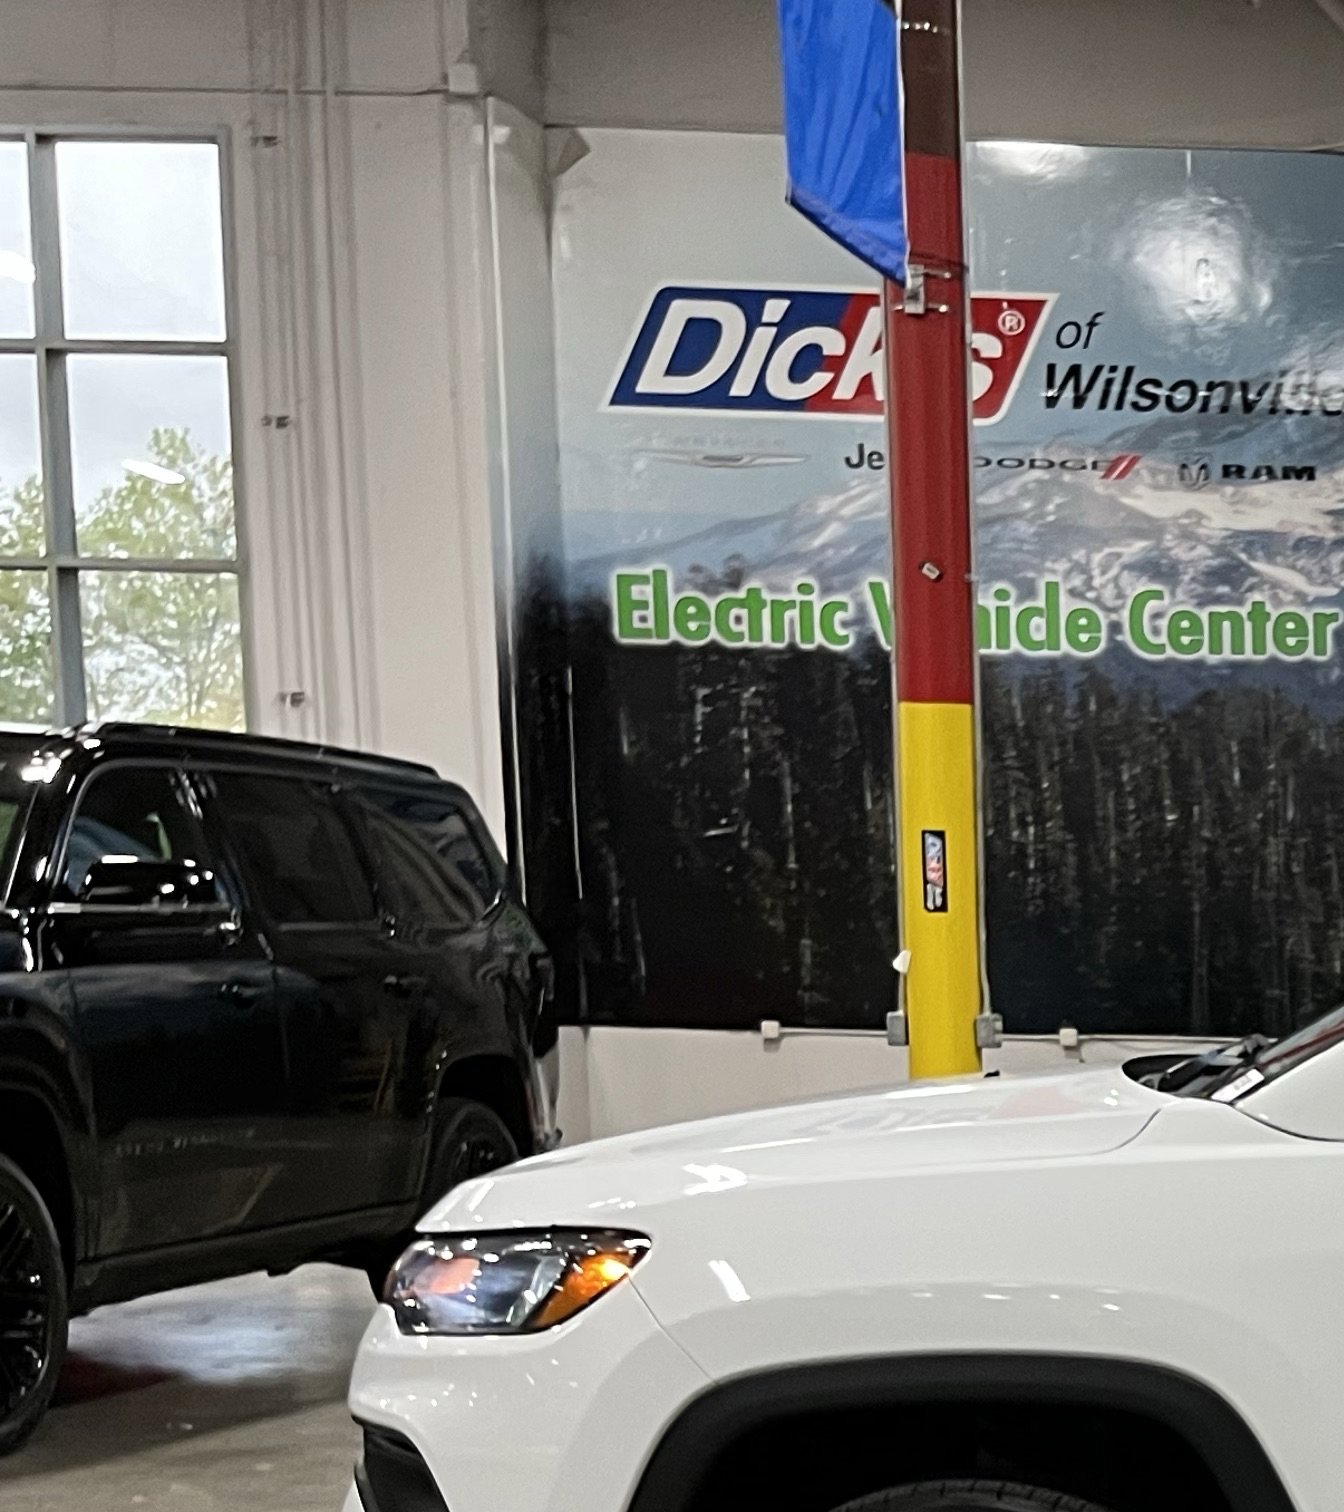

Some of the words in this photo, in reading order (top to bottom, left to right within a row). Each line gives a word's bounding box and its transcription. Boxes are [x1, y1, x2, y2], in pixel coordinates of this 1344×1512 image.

[1054, 311, 1106, 350] of
[844, 443, 885, 471] Je
[1222, 464, 1317, 481] RAM
[614, 568, 851, 647] Electric
[867, 580, 1103, 652] Vicle
[1128, 588, 1340, 657] Center
